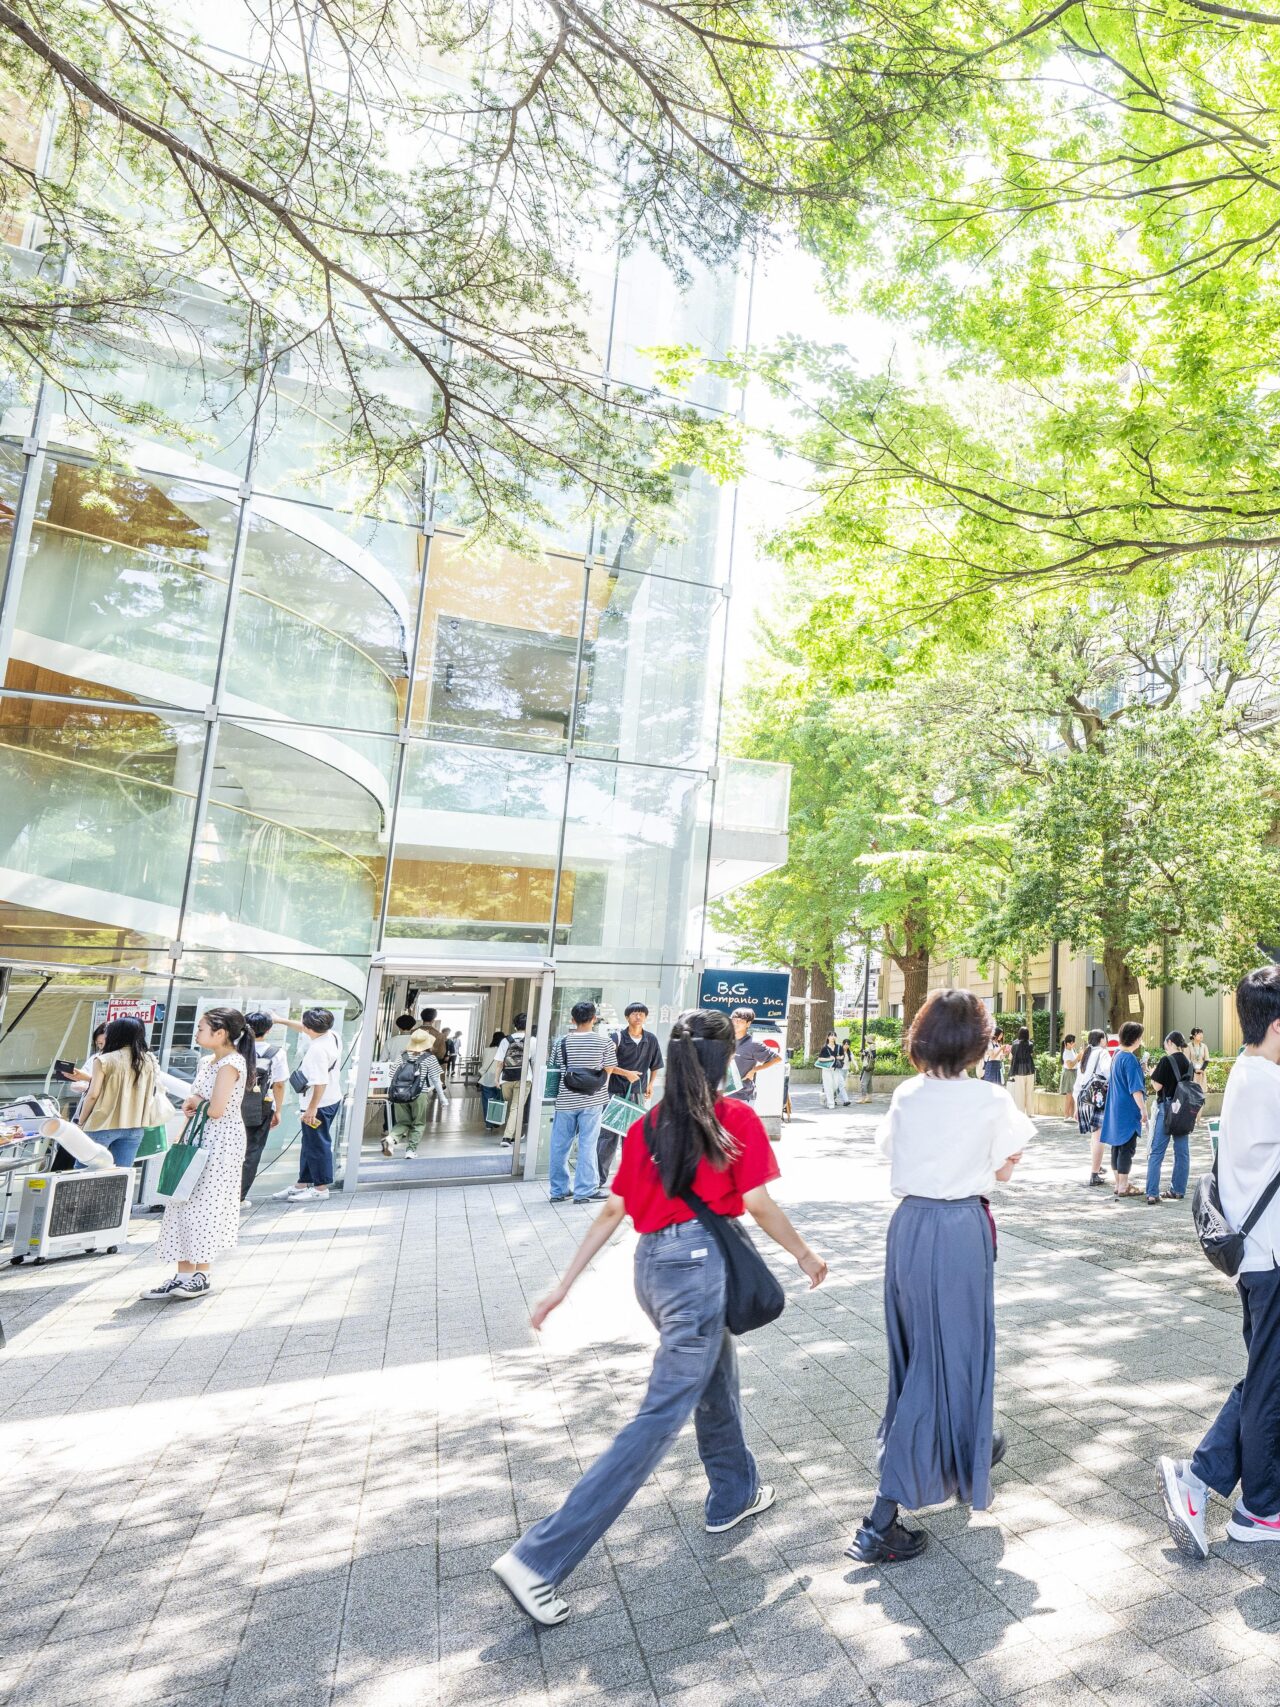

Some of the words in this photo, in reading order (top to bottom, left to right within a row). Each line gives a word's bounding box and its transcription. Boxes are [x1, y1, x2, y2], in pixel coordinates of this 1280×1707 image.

[717, 981, 749, 995] B.G
[703, 994, 758, 1007] Companio
[762, 997, 784, 1006] Inc.
